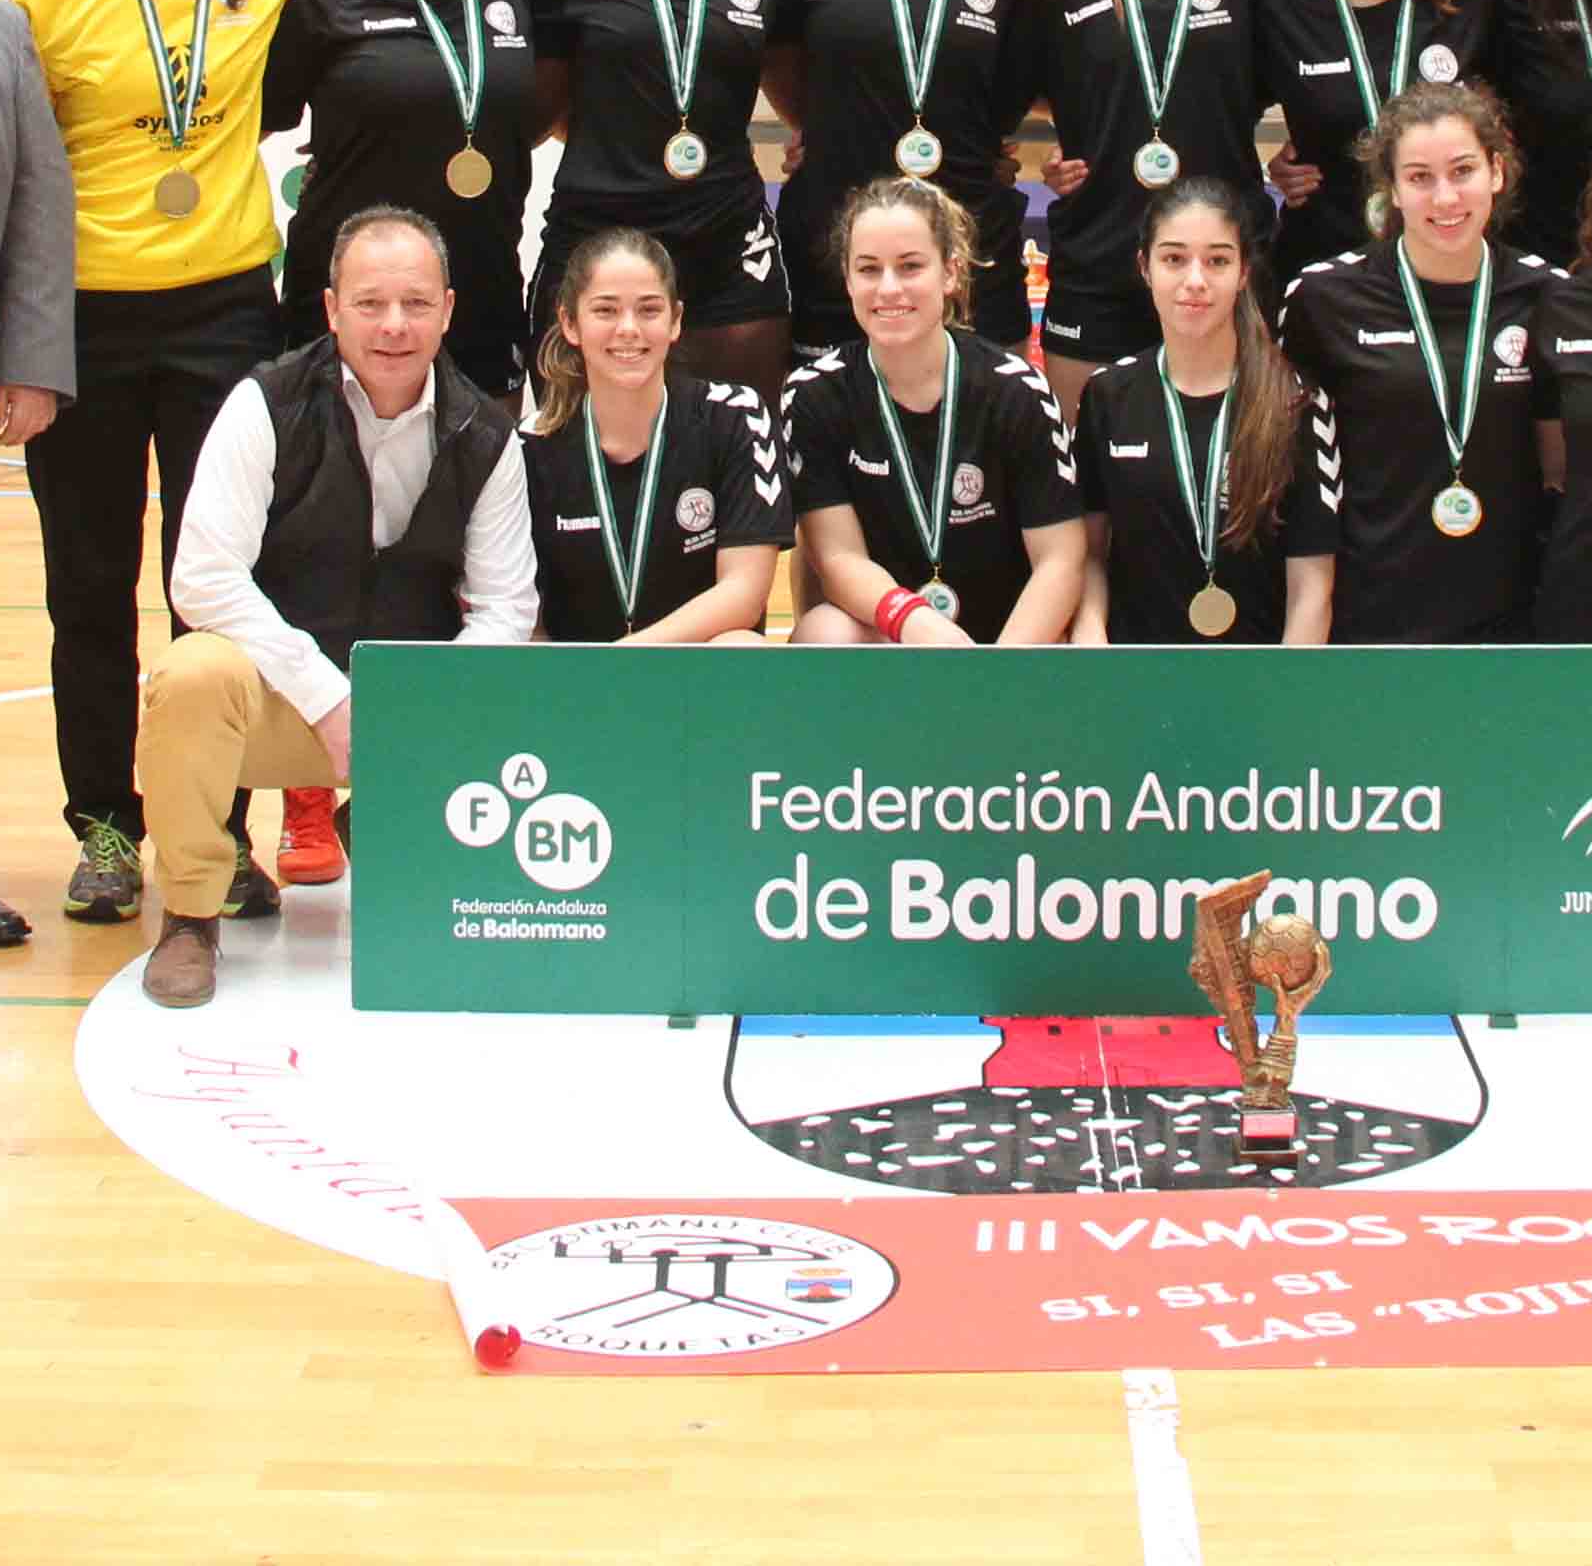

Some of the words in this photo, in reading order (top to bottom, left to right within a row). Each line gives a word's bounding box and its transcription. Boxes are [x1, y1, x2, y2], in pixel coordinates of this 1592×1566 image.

[513, 761, 535, 787] A
[469, 797, 489, 832] F
[749, 767, 1112, 832] Federación
[1126, 767, 1442, 832] Andaluza
[528, 820, 599, 863] BM
[452, 897, 534, 915] Federación
[535, 898, 607, 915] Andaluza
[754, 852, 870, 941] de
[453, 915, 480, 938] de
[483, 916, 607, 939] Balonmano
[1080, 1214, 1408, 1251] VAMOS
[1041, 1293, 1142, 1322] SI,
[1158, 1280, 1257, 1310] SI,
[1273, 1269, 1353, 1296] SI
[1201, 1310, 1358, 1349] LAS
